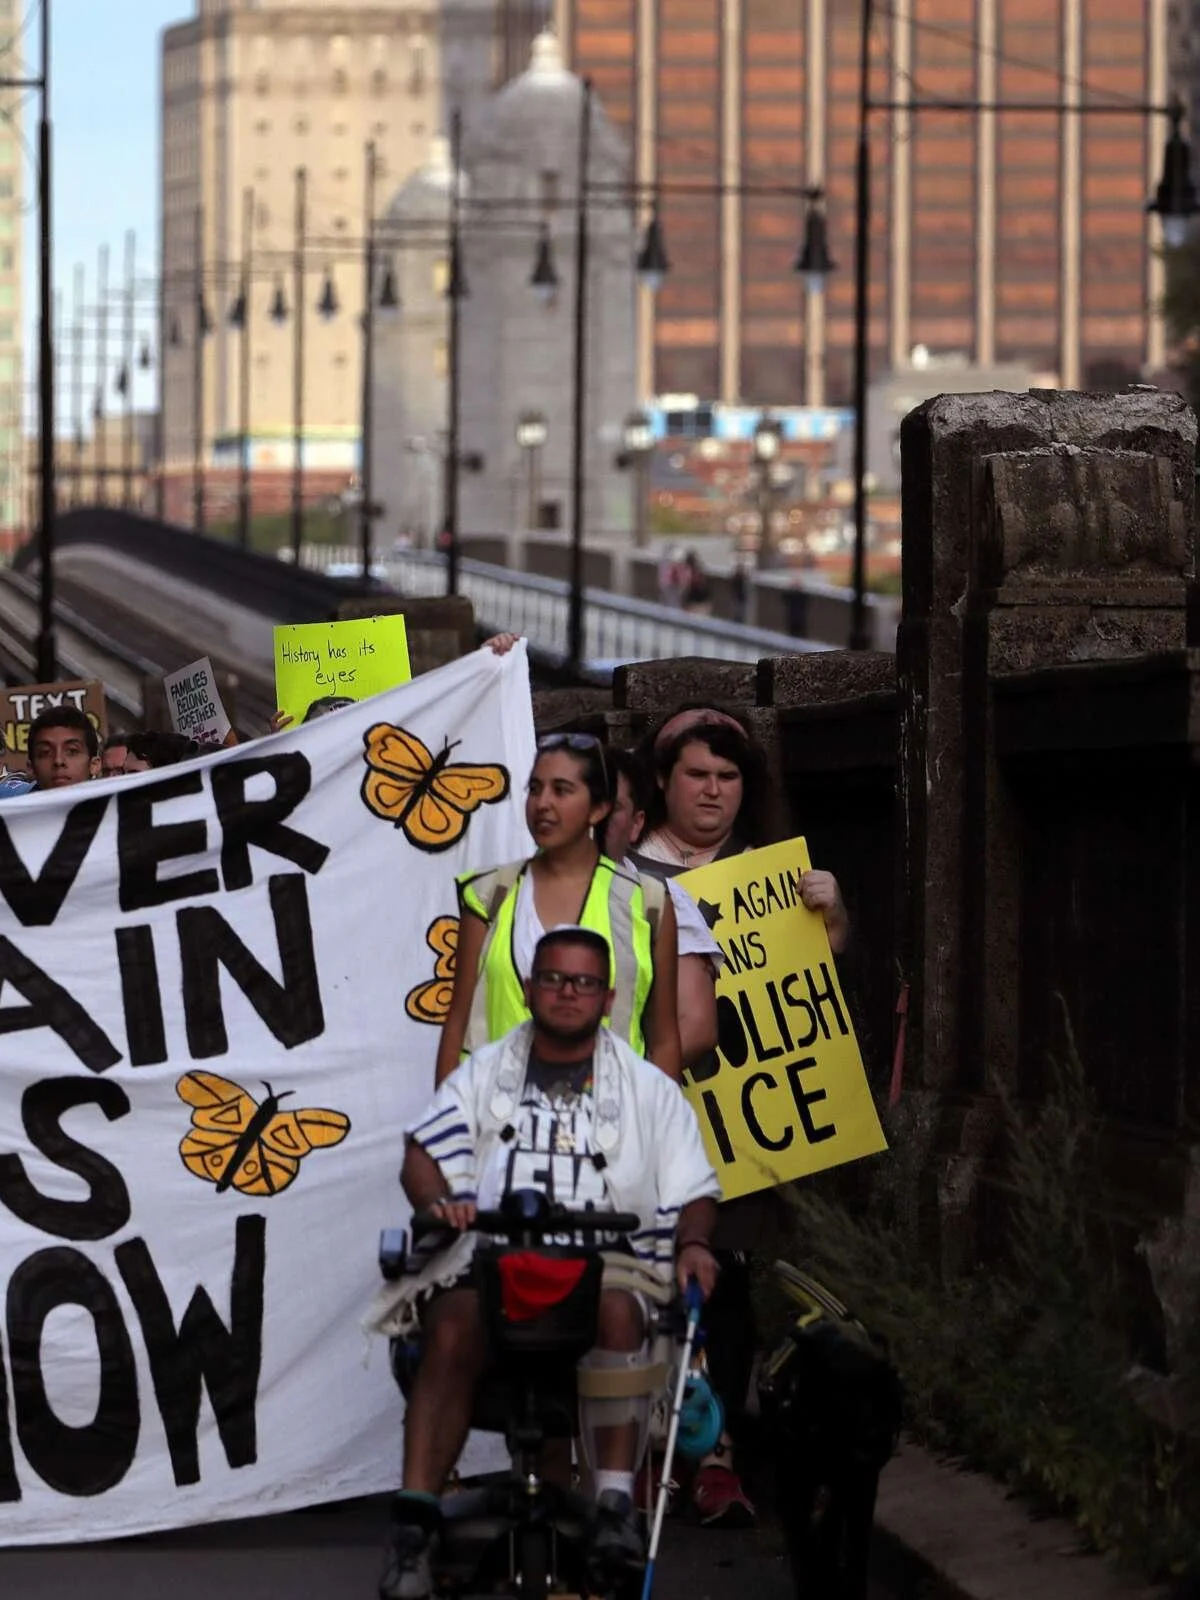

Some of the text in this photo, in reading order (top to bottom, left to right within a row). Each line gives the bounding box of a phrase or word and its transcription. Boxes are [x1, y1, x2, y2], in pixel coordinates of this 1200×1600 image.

[282, 638, 375, 673] History has its
[170, 670, 208, 701] FAMILIES
[315, 668, 357, 696] eyes
[176, 688, 209, 716] BELONG
[177, 702, 217, 733] TOGETHER
[733, 867, 801, 925] AGAIN
[701, 1056, 837, 1165] ICE
